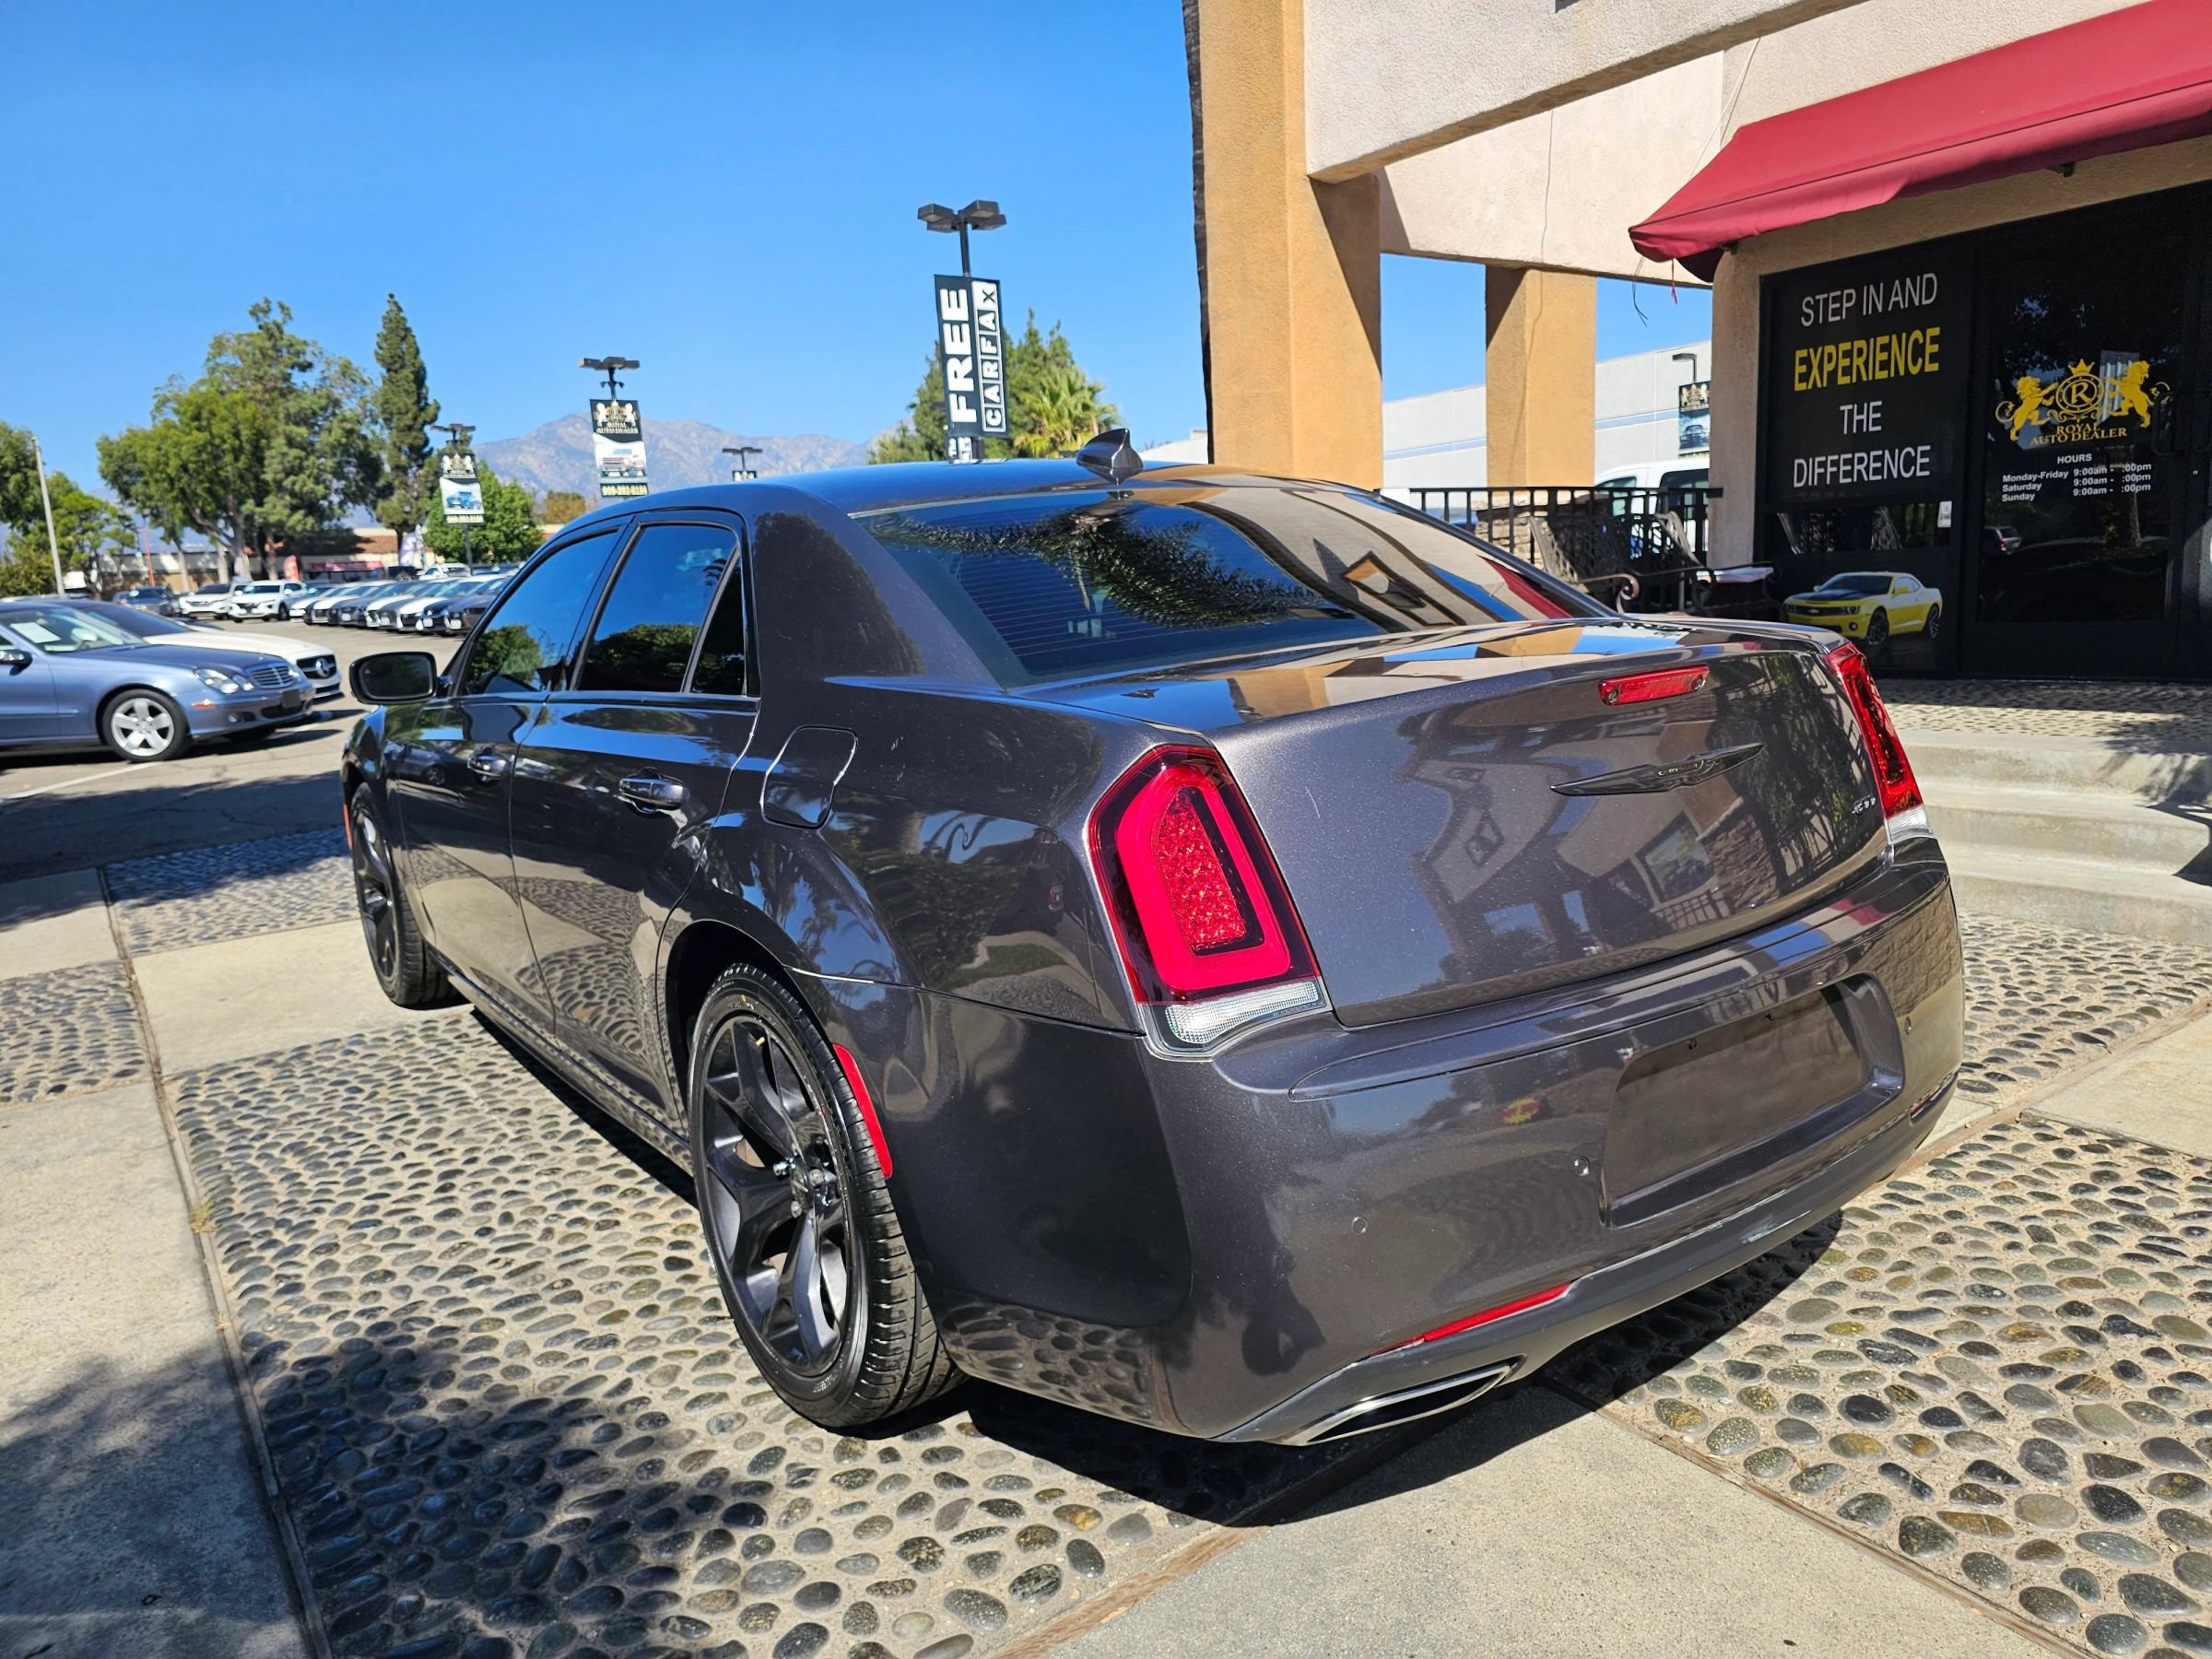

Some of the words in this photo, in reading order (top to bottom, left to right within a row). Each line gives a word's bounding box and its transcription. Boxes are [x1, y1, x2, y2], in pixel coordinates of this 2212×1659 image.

[1801, 288, 1856, 327] STEP
[1863, 282, 1884, 316] IN
[1888, 273, 1938, 312] AND
[939, 288, 977, 423] FREE
[977, 288, 1003, 428] CARFAX
[1794, 326, 1941, 392] EXPERIENCE
[2070, 382, 2093, 405] R
[1840, 400, 1883, 435] THE
[2056, 423, 2100, 435] ROYAL
[2030, 432, 2068, 446] AUTO
[2071, 428, 2127, 441] DEALER
[1794, 445, 1931, 488] DIFFERENCE
[2057, 453, 2092, 465] HOURS
[2002, 482, 2042, 493] Saturday
[2074, 477, 2108, 487] 9:00am
[2003, 470, 2069, 483] Monday-Friday
[2074, 466, 2108, 477] 9:00am
[2002, 492, 2036, 502] Sunday
[2073, 487, 2107, 497] 9:00am
